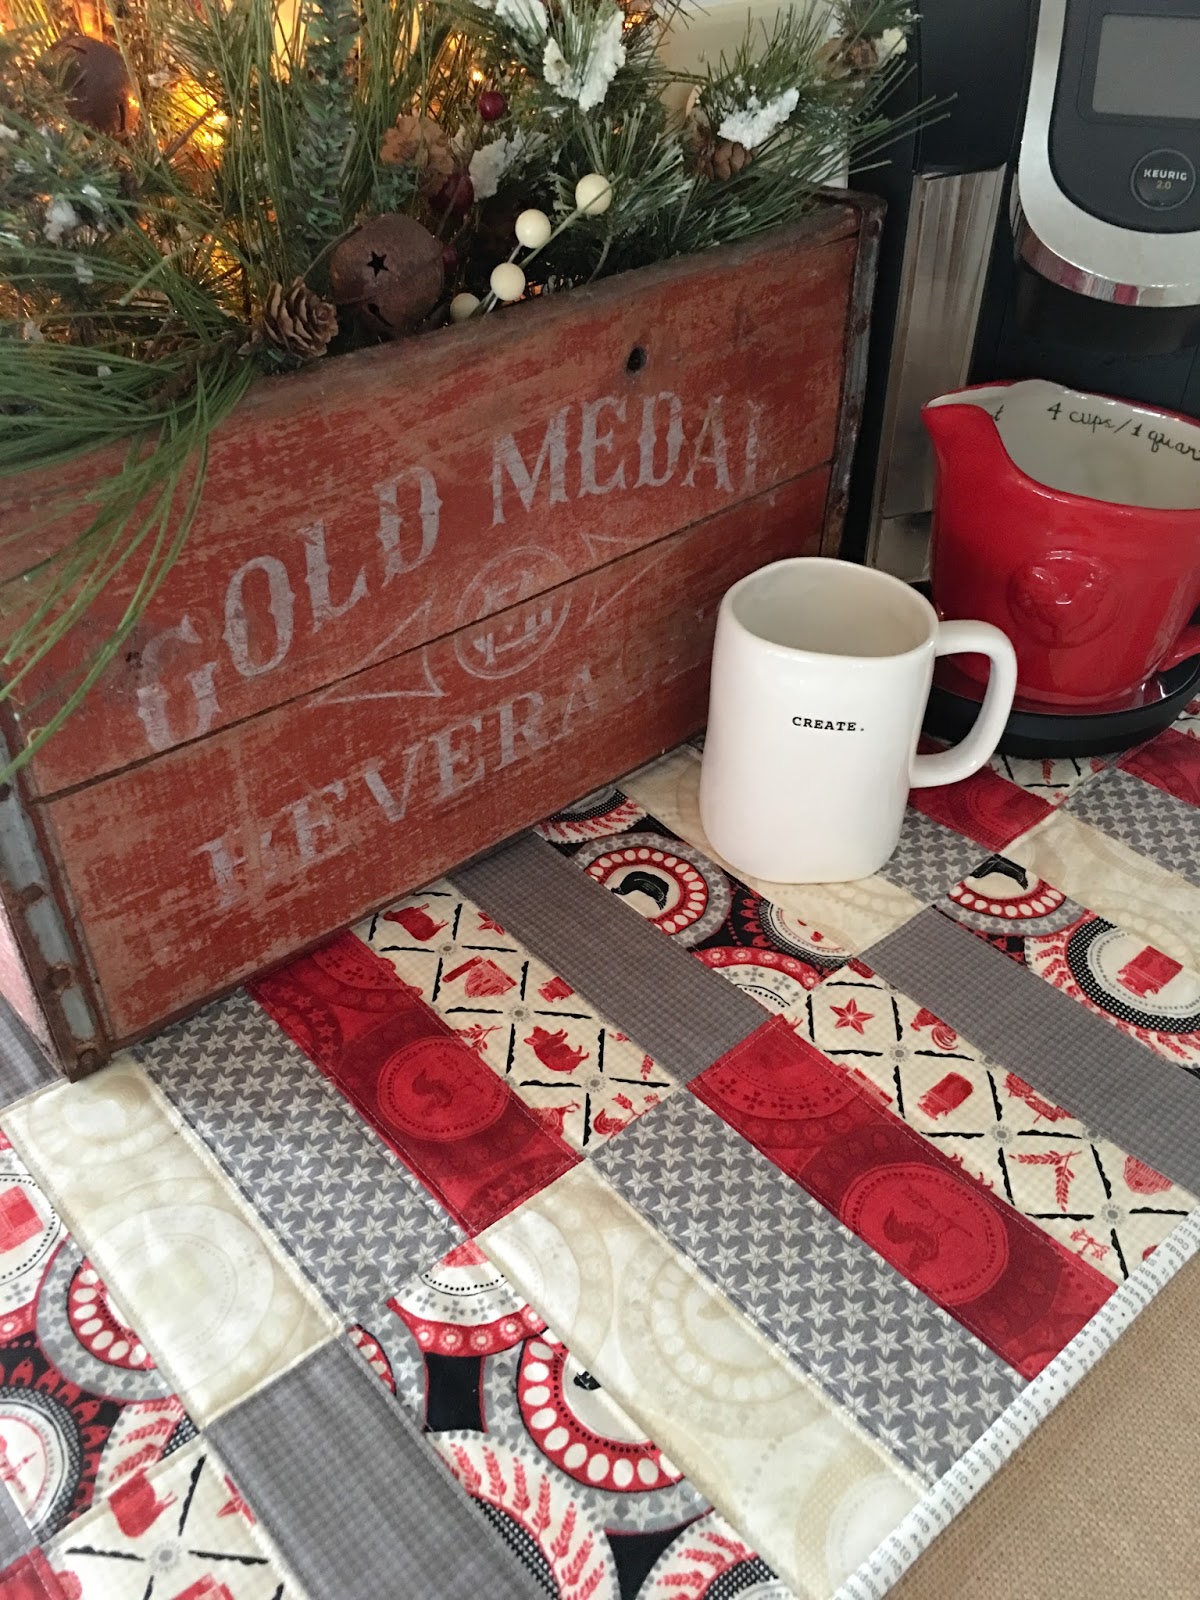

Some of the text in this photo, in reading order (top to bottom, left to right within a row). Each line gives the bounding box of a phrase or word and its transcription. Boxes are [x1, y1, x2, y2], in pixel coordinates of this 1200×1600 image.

[1143, 168, 1188, 182] KEURIG
[1156, 180, 1173, 191] 2.0
[1047, 402, 1063, 421] 4
[1148, 430, 1200, 461] quar
[135, 466, 444, 752] GOLD
[791, 716, 865, 732] CREATE.
